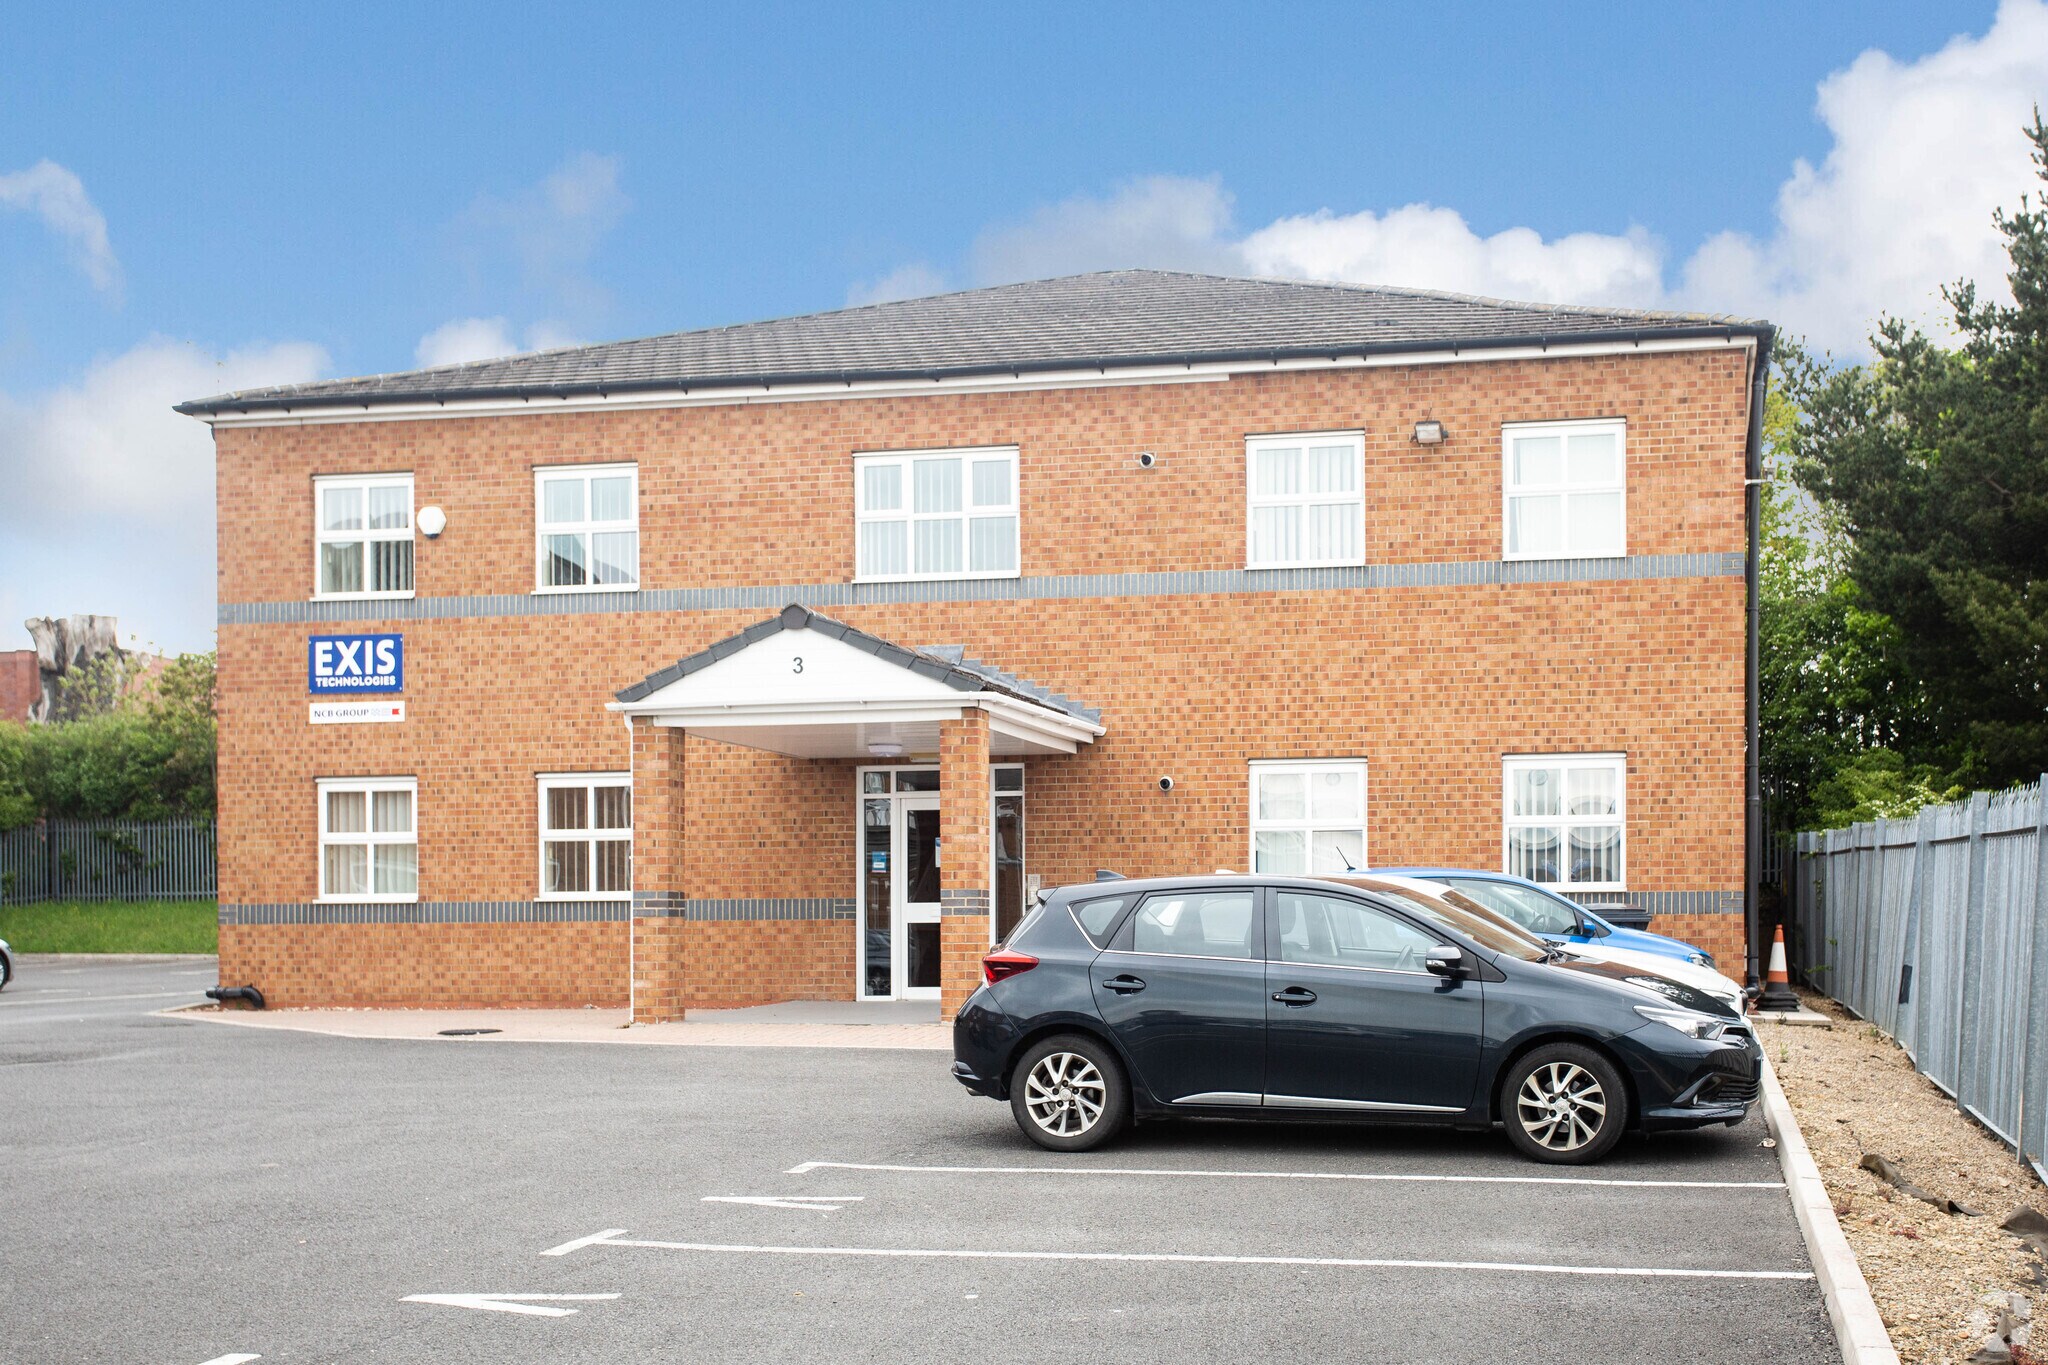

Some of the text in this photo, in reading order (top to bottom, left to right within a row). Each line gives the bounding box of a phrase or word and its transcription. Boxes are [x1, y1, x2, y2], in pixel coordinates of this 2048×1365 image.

[315, 639, 396, 676] EXIS
[793, 656, 804, 674] 3
[315, 675, 396, 687] TECHNOLOGIES
[314, 708, 369, 717] NCB GROUP
